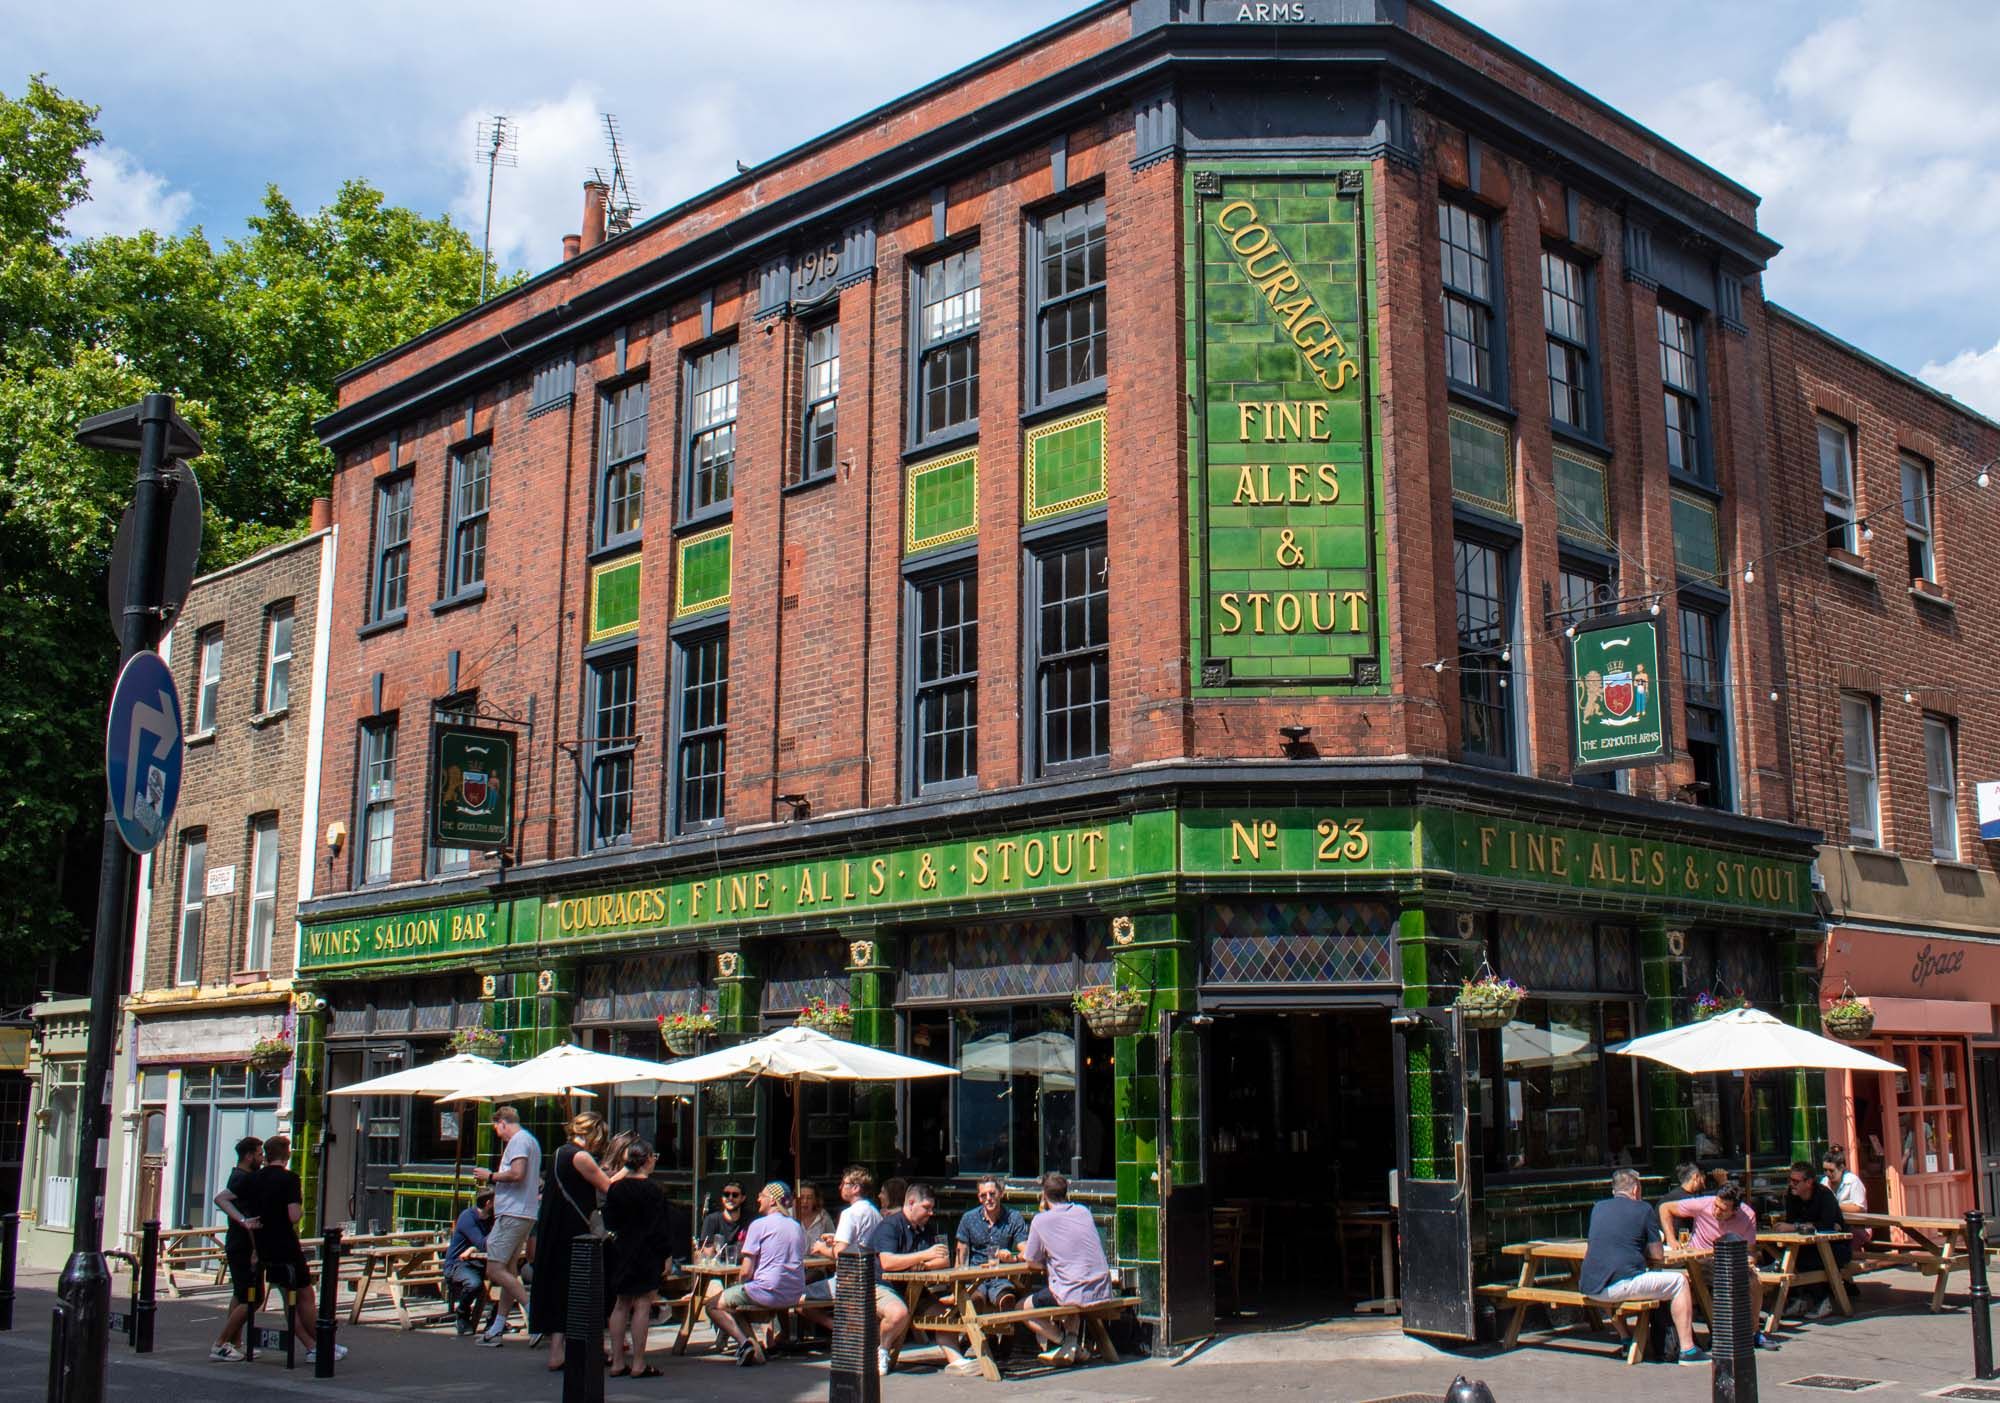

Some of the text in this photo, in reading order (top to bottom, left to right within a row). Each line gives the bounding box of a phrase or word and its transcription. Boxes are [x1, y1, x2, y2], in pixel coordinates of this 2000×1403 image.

[797, 243, 839, 289] 1915
[1218, 200, 1359, 392] COURAGES
[1238, 401, 1331, 442] FINE
[1232, 463, 1339, 505] ALES
[1276, 528, 1304, 568] &
[1219, 591, 1369, 633] STOUT
[1582, 731, 1659, 751] THE EXMOUTH ARMS
[1317, 818, 1369, 861] 23
[560, 887, 665, 931] COURAGES
[691, 872, 770, 916] FINE
[918, 852, 937, 890] &
[971, 831, 1104, 885] STOUT
[1479, 826, 1795, 904] FINE ALES & STOUT
[310, 912, 486, 956] WINES SALOON BAR
[1911, 943, 1965, 988] Space
